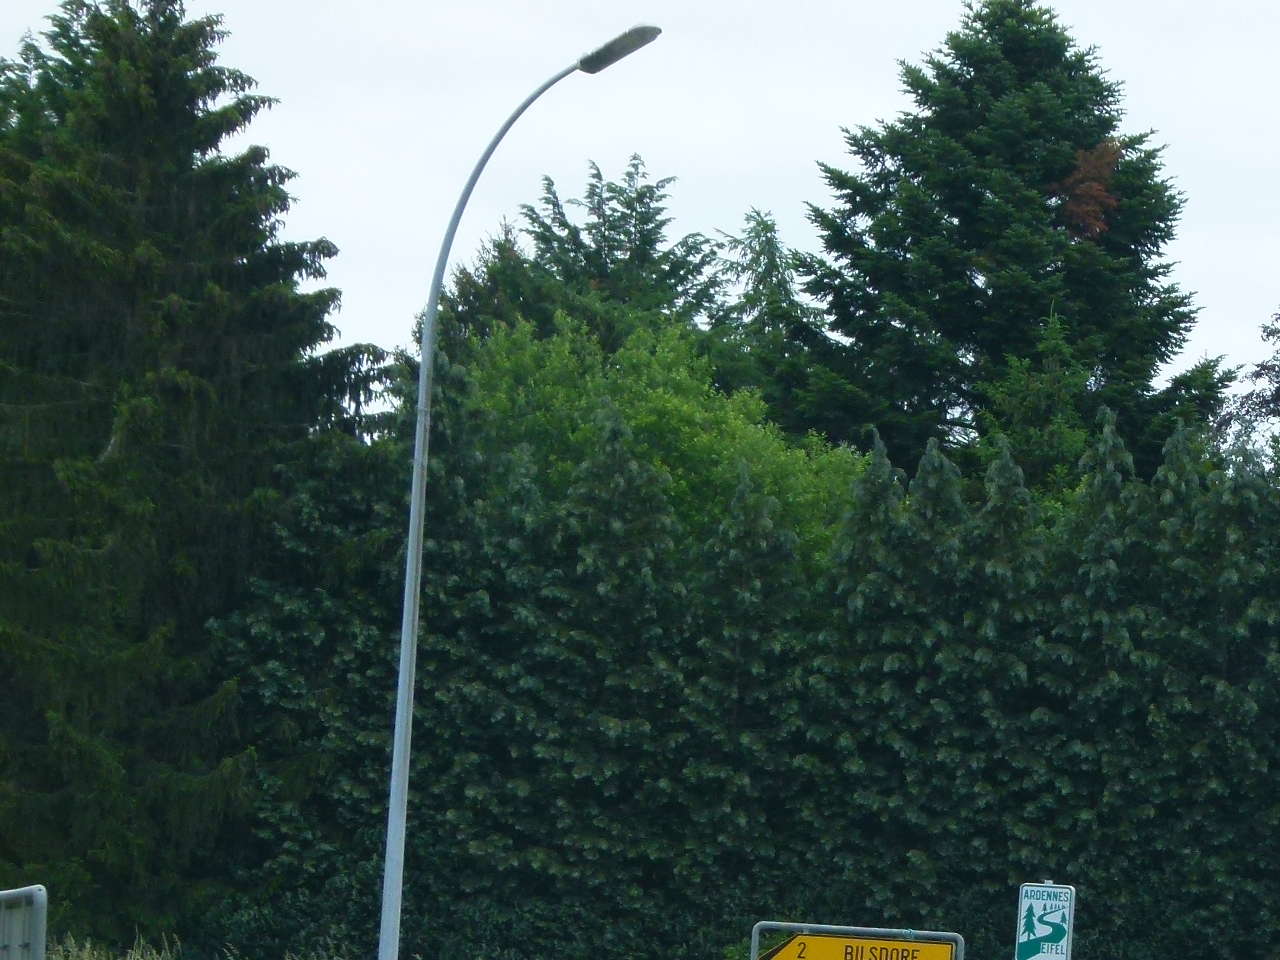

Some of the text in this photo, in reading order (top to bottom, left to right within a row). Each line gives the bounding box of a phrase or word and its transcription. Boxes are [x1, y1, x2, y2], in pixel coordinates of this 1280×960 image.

[1023, 889, 1069, 902] ARDENNES
[797, 942, 807, 960] 2
[1041, 943, 1065, 955] EIFEL
